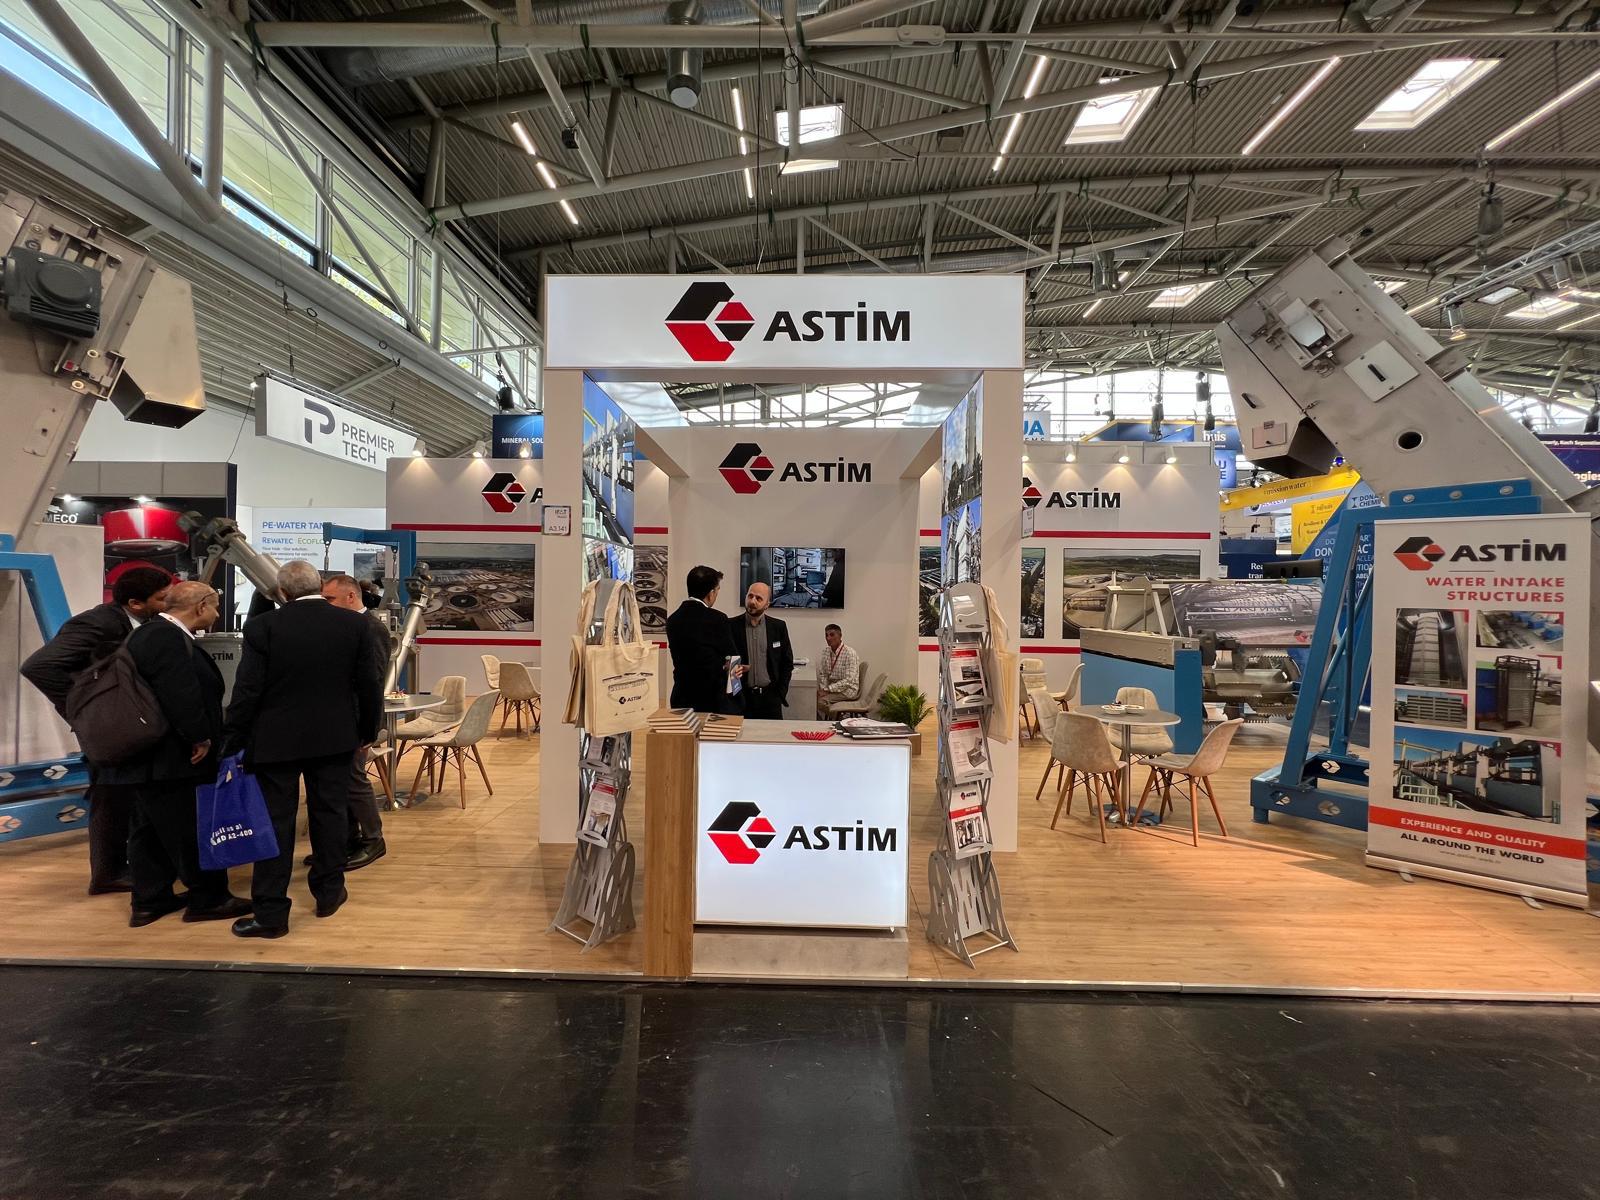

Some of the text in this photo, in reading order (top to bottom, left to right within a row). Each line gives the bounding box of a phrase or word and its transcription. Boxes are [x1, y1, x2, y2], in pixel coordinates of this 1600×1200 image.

[342, 422, 395, 454] PREMIER
[342, 440, 376, 465] TECH
[262, 521, 307, 530] PE-WATER
[1426, 577, 1565, 588] WATER INTAKE
[1447, 591, 1565, 603] STRUCTURES
[1400, 818, 1546, 849] EXPERIENCE AND QUALITY
[1400, 833, 1419, 842] ALL
[1422, 836, 1471, 851] AROUND
[1475, 845, 1496, 856] THE
[1500, 850, 1545, 864] WORLD
